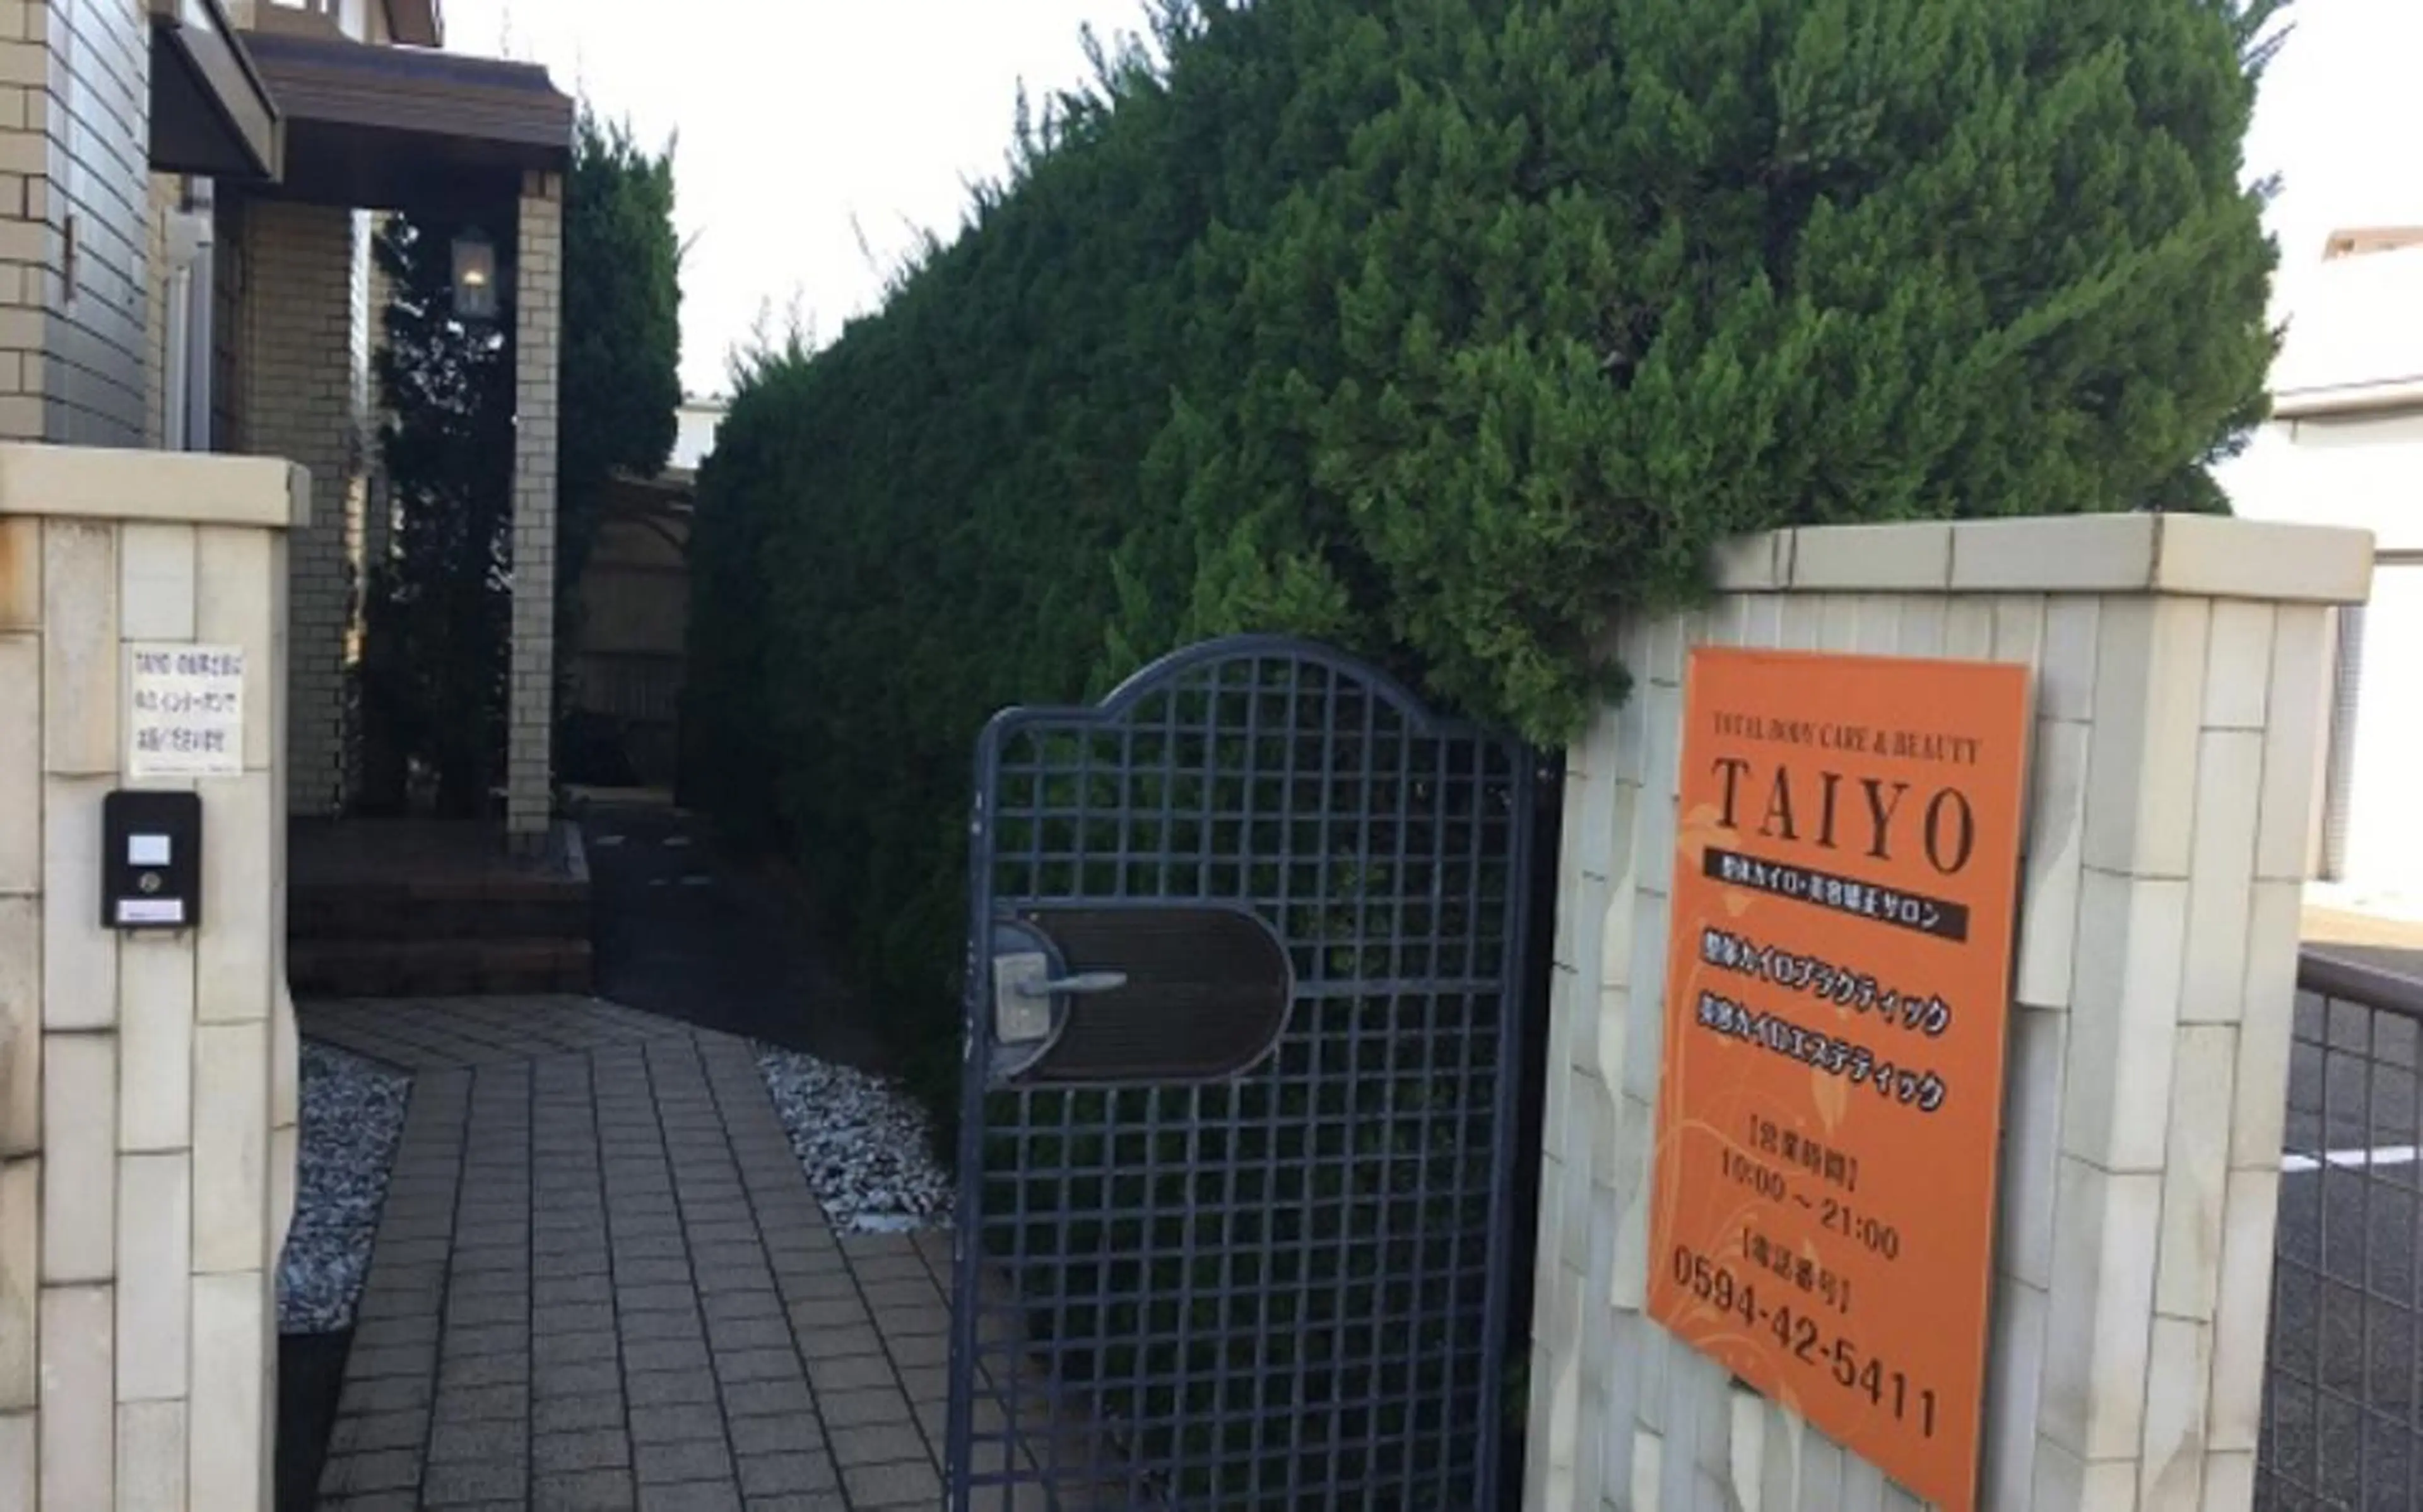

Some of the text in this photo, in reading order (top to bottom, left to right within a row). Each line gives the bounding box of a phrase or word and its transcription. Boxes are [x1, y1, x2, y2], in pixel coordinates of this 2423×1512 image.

[1714, 711, 1983, 766] TOTAL BODY CARE & BEAUTY
[1711, 757, 1975, 876] TAIYO
[1722, 1146, 1786, 1203] 10:00
[1820, 1198, 1899, 1260] 21:00
[1672, 1245, 1935, 1438] 0594-42-5411
